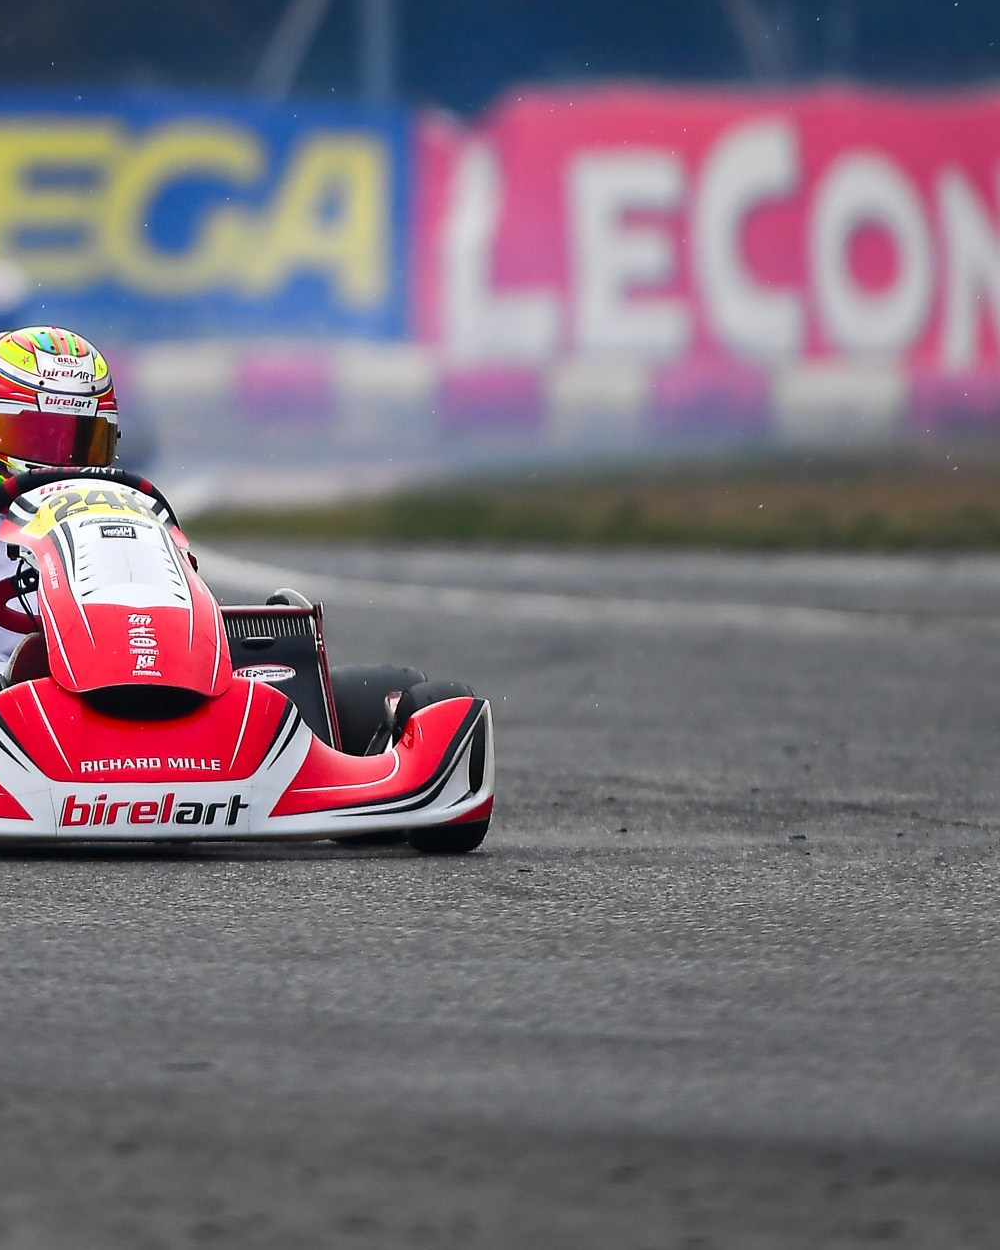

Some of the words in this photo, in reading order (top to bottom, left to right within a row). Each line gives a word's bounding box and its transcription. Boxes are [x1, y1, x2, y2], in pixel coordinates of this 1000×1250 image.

[45, 396, 92, 408] birelart
[81, 757, 161, 773] RICHARD
[168, 757, 221, 771] MILLE
[60, 793, 249, 827] birelart
